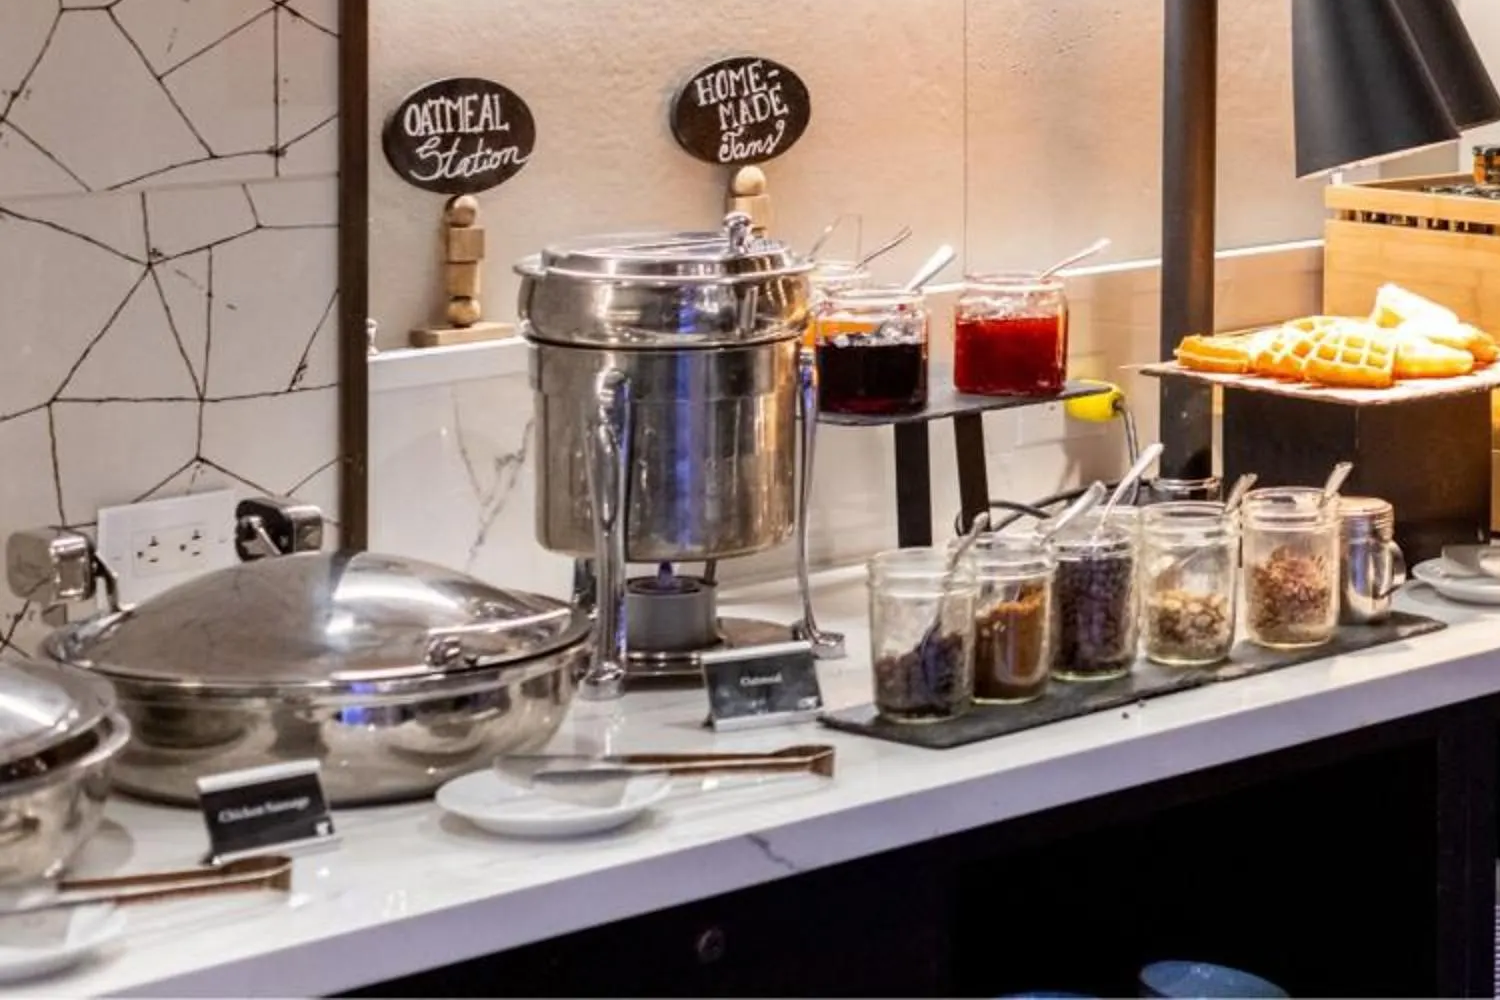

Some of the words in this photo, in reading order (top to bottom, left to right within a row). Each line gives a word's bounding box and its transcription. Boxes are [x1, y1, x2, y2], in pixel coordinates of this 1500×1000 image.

[403, 93, 510, 137] OATMEAL
[718, 82, 789, 130] MADE
[409, 136, 530, 181] Station
